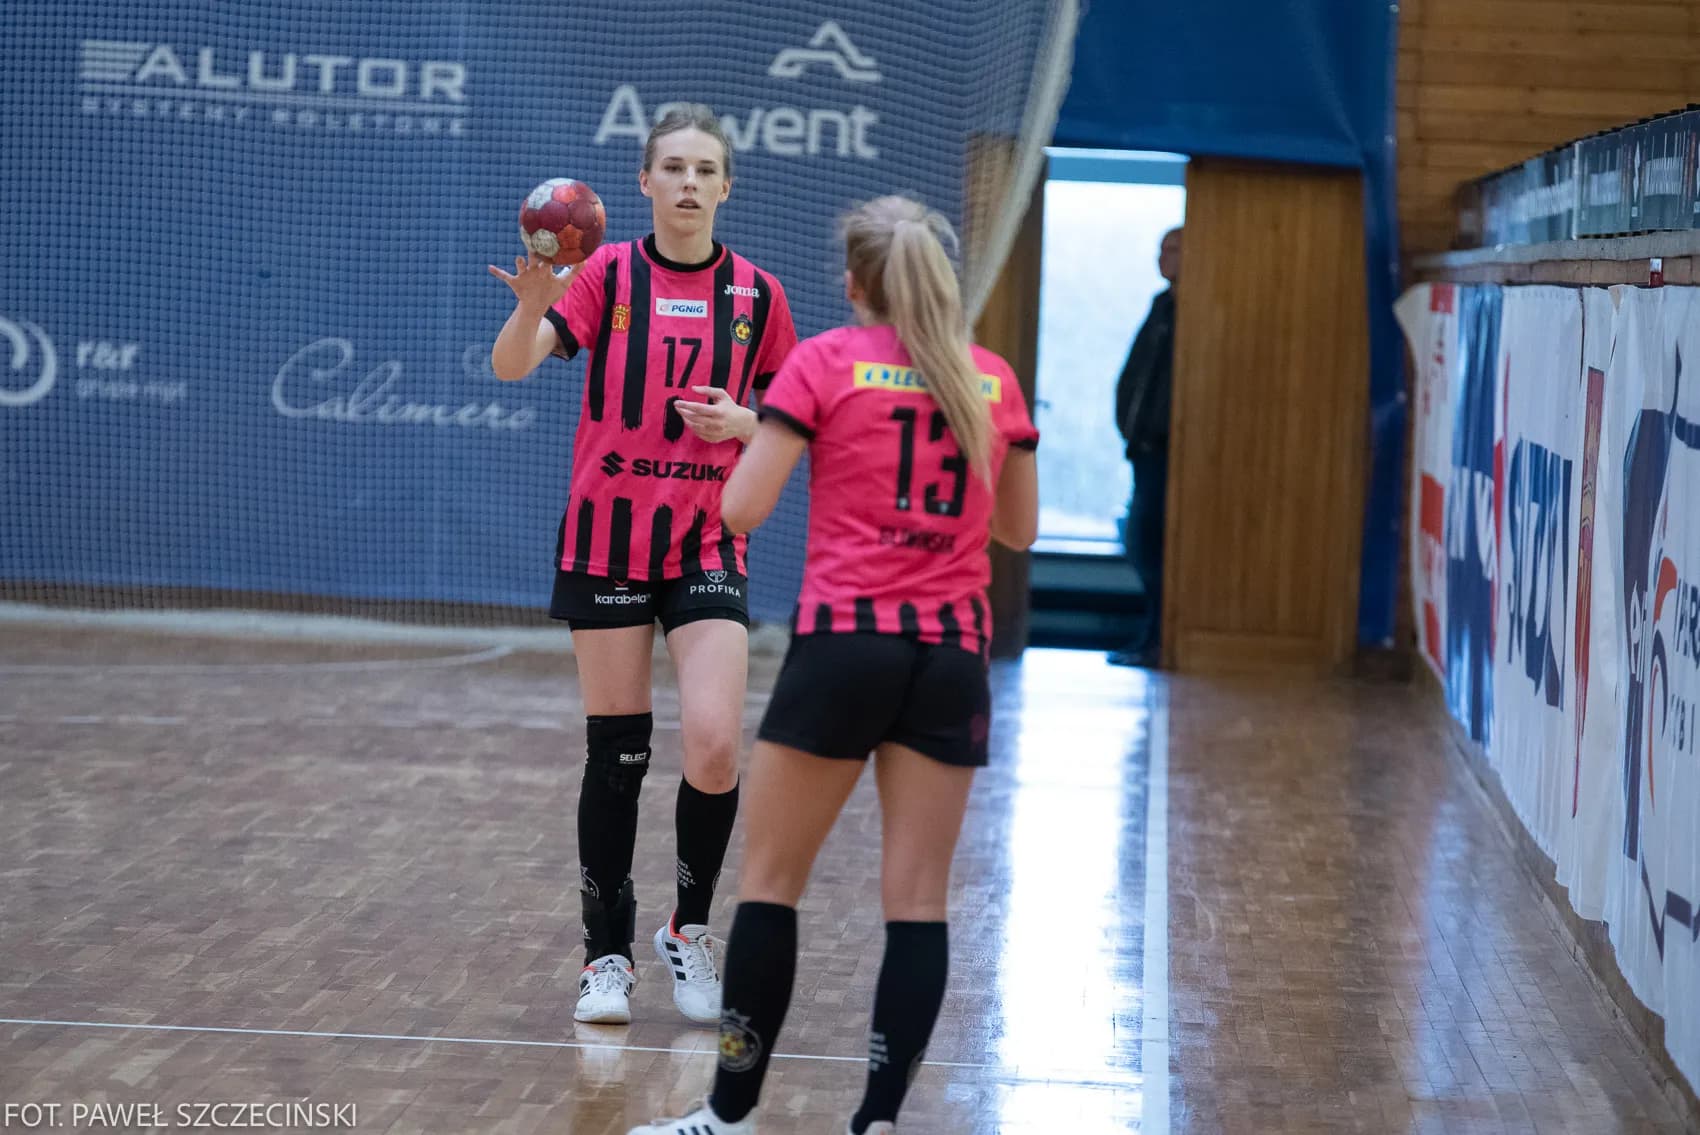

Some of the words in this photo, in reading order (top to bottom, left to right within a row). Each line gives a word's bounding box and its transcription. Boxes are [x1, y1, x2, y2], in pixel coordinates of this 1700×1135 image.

[135, 43, 466, 100] ALUTOR
[594, 84, 879, 158] Awent
[271, 337, 536, 429] Calimero
[662, 335, 702, 389] 17
[889, 406, 968, 518] 13
[595, 593, 647, 605] karabela
[690, 584, 741, 598] PROFIKA
[620, 752, 647, 761] SELECT
